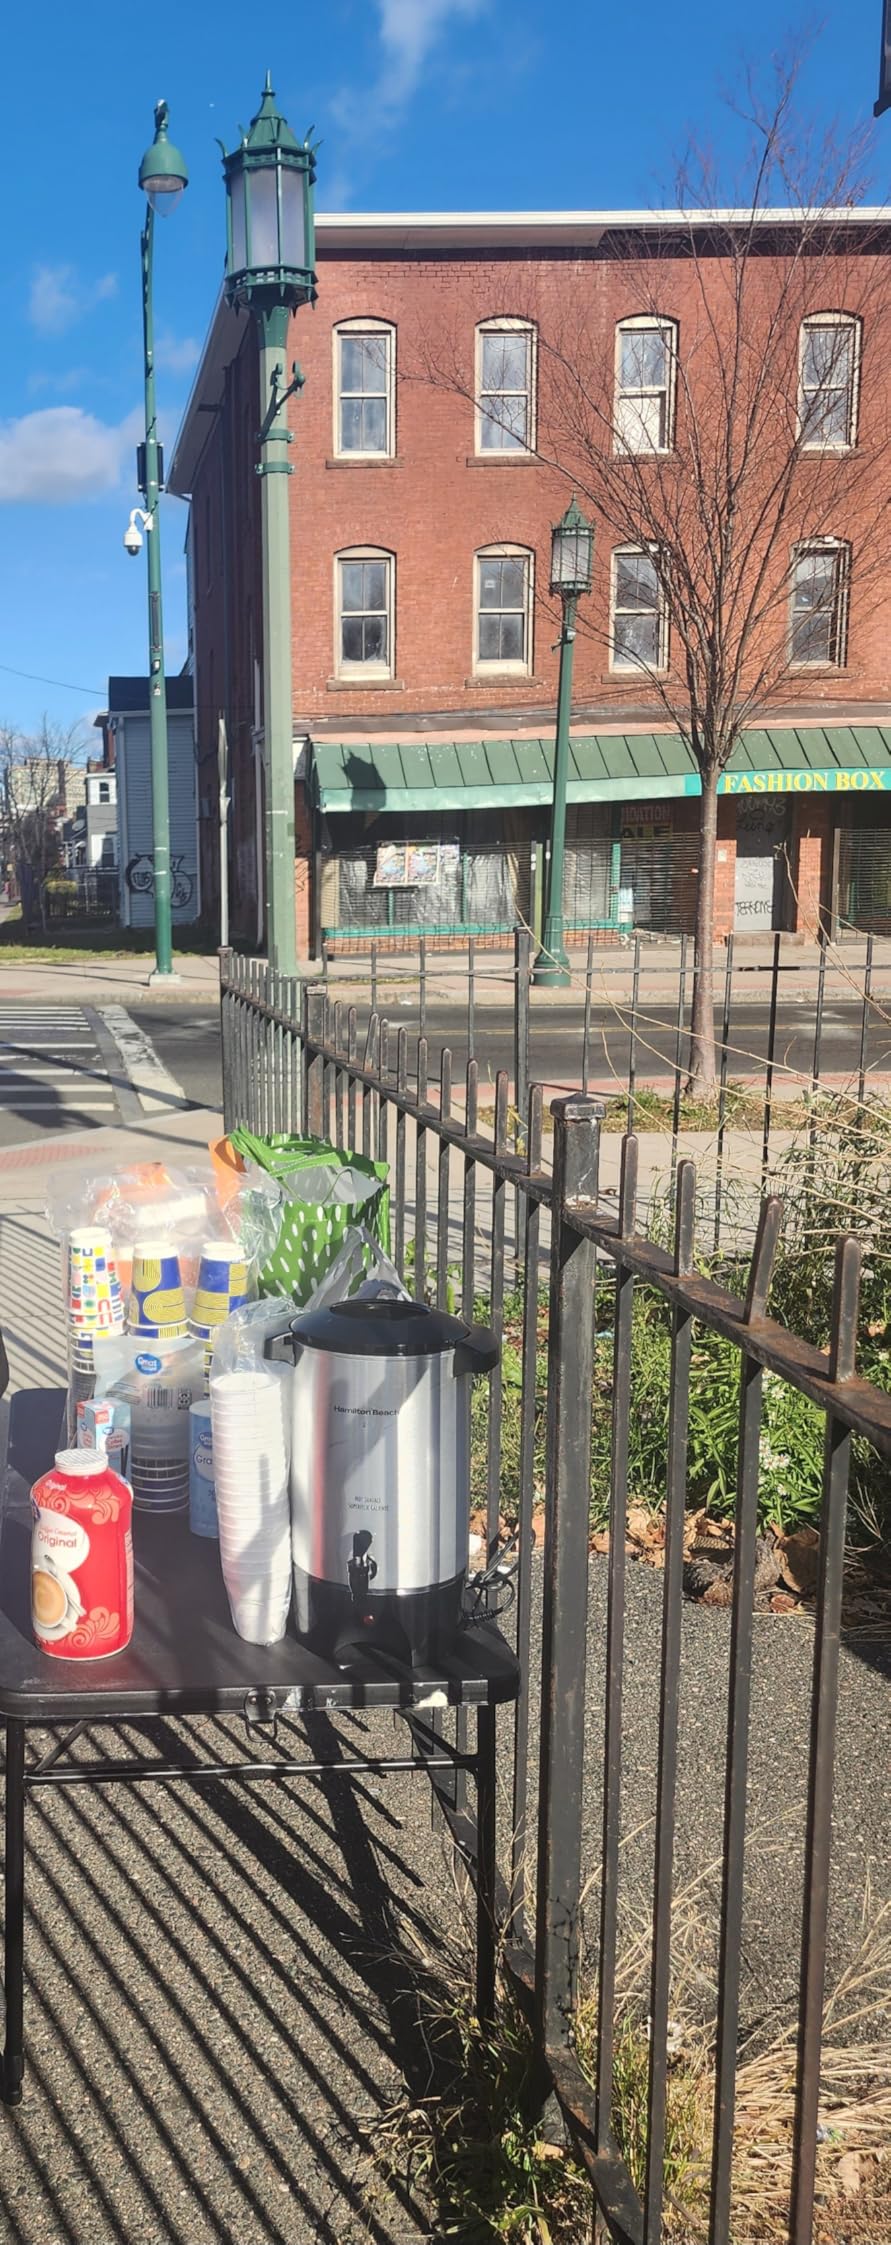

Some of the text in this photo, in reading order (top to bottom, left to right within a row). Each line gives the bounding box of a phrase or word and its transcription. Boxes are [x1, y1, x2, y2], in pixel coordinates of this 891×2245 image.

[724, 771, 886, 793] FASHION BOX
[621, 825, 671, 839] ALE
[334, 1405, 372, 1416] Hamilton
[37, 1530, 77, 1549] Original
